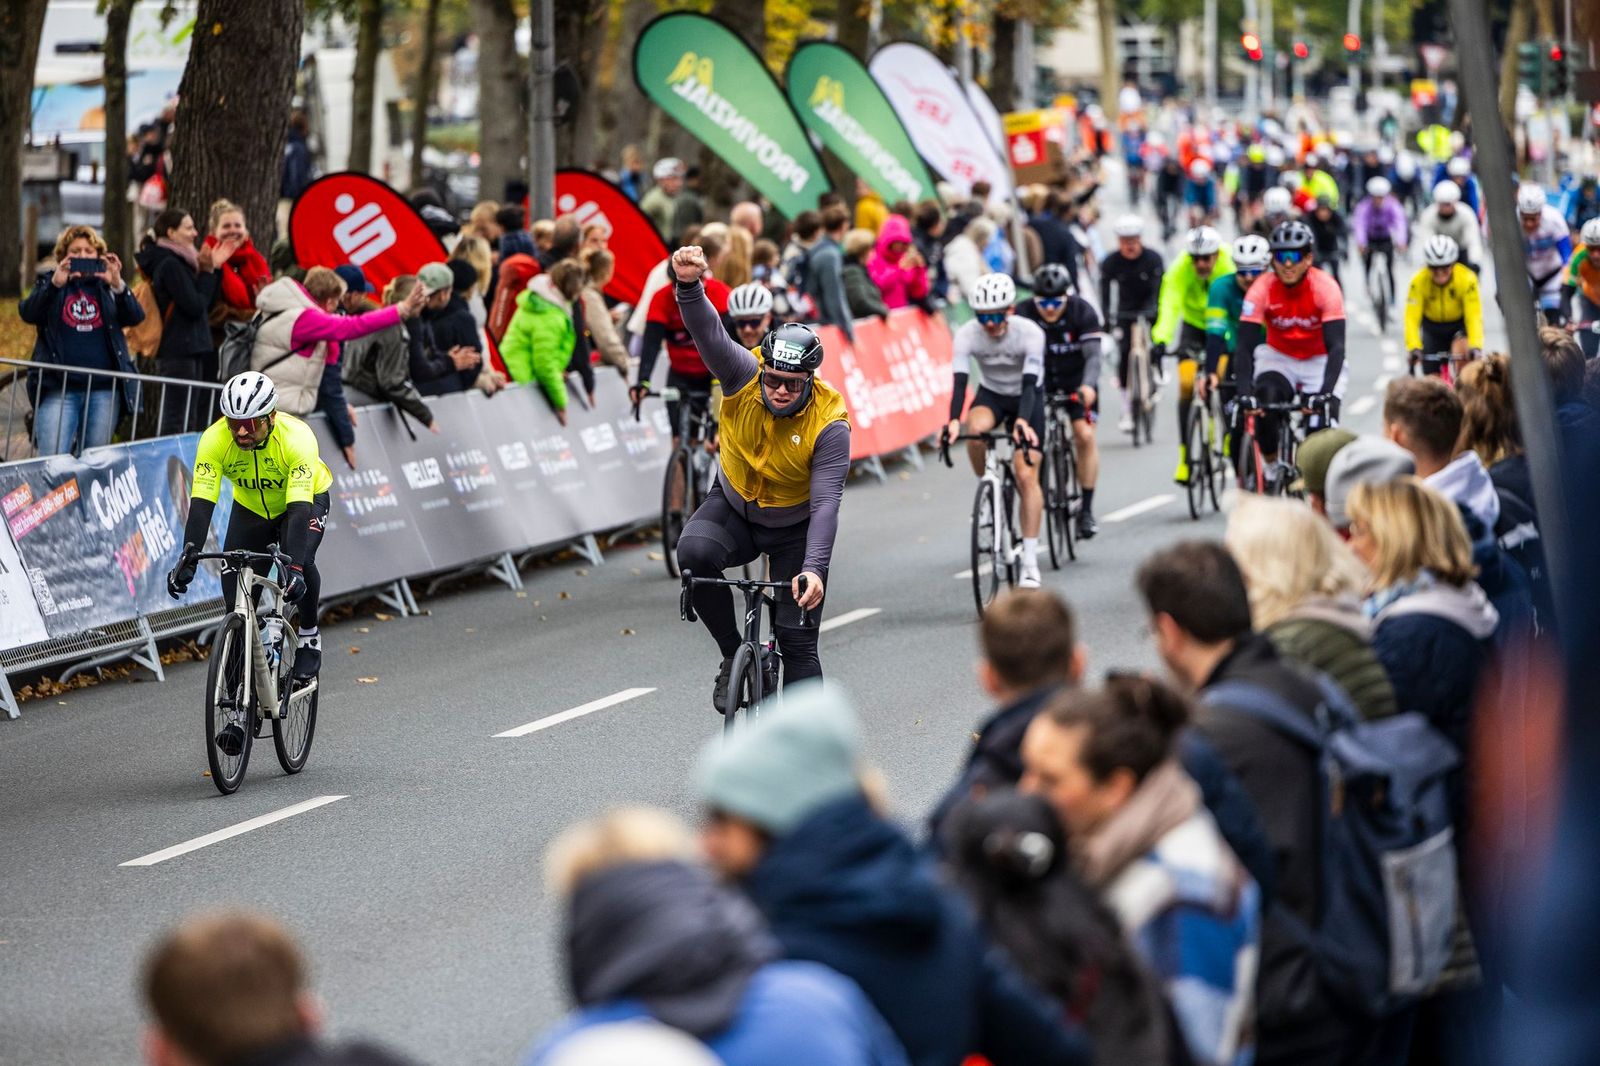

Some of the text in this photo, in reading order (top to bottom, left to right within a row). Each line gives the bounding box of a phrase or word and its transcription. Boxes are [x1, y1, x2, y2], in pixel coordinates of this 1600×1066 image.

[90, 463, 143, 531] Colour
[237, 478, 284, 490] JURY
[113, 496, 176, 597] your life!
